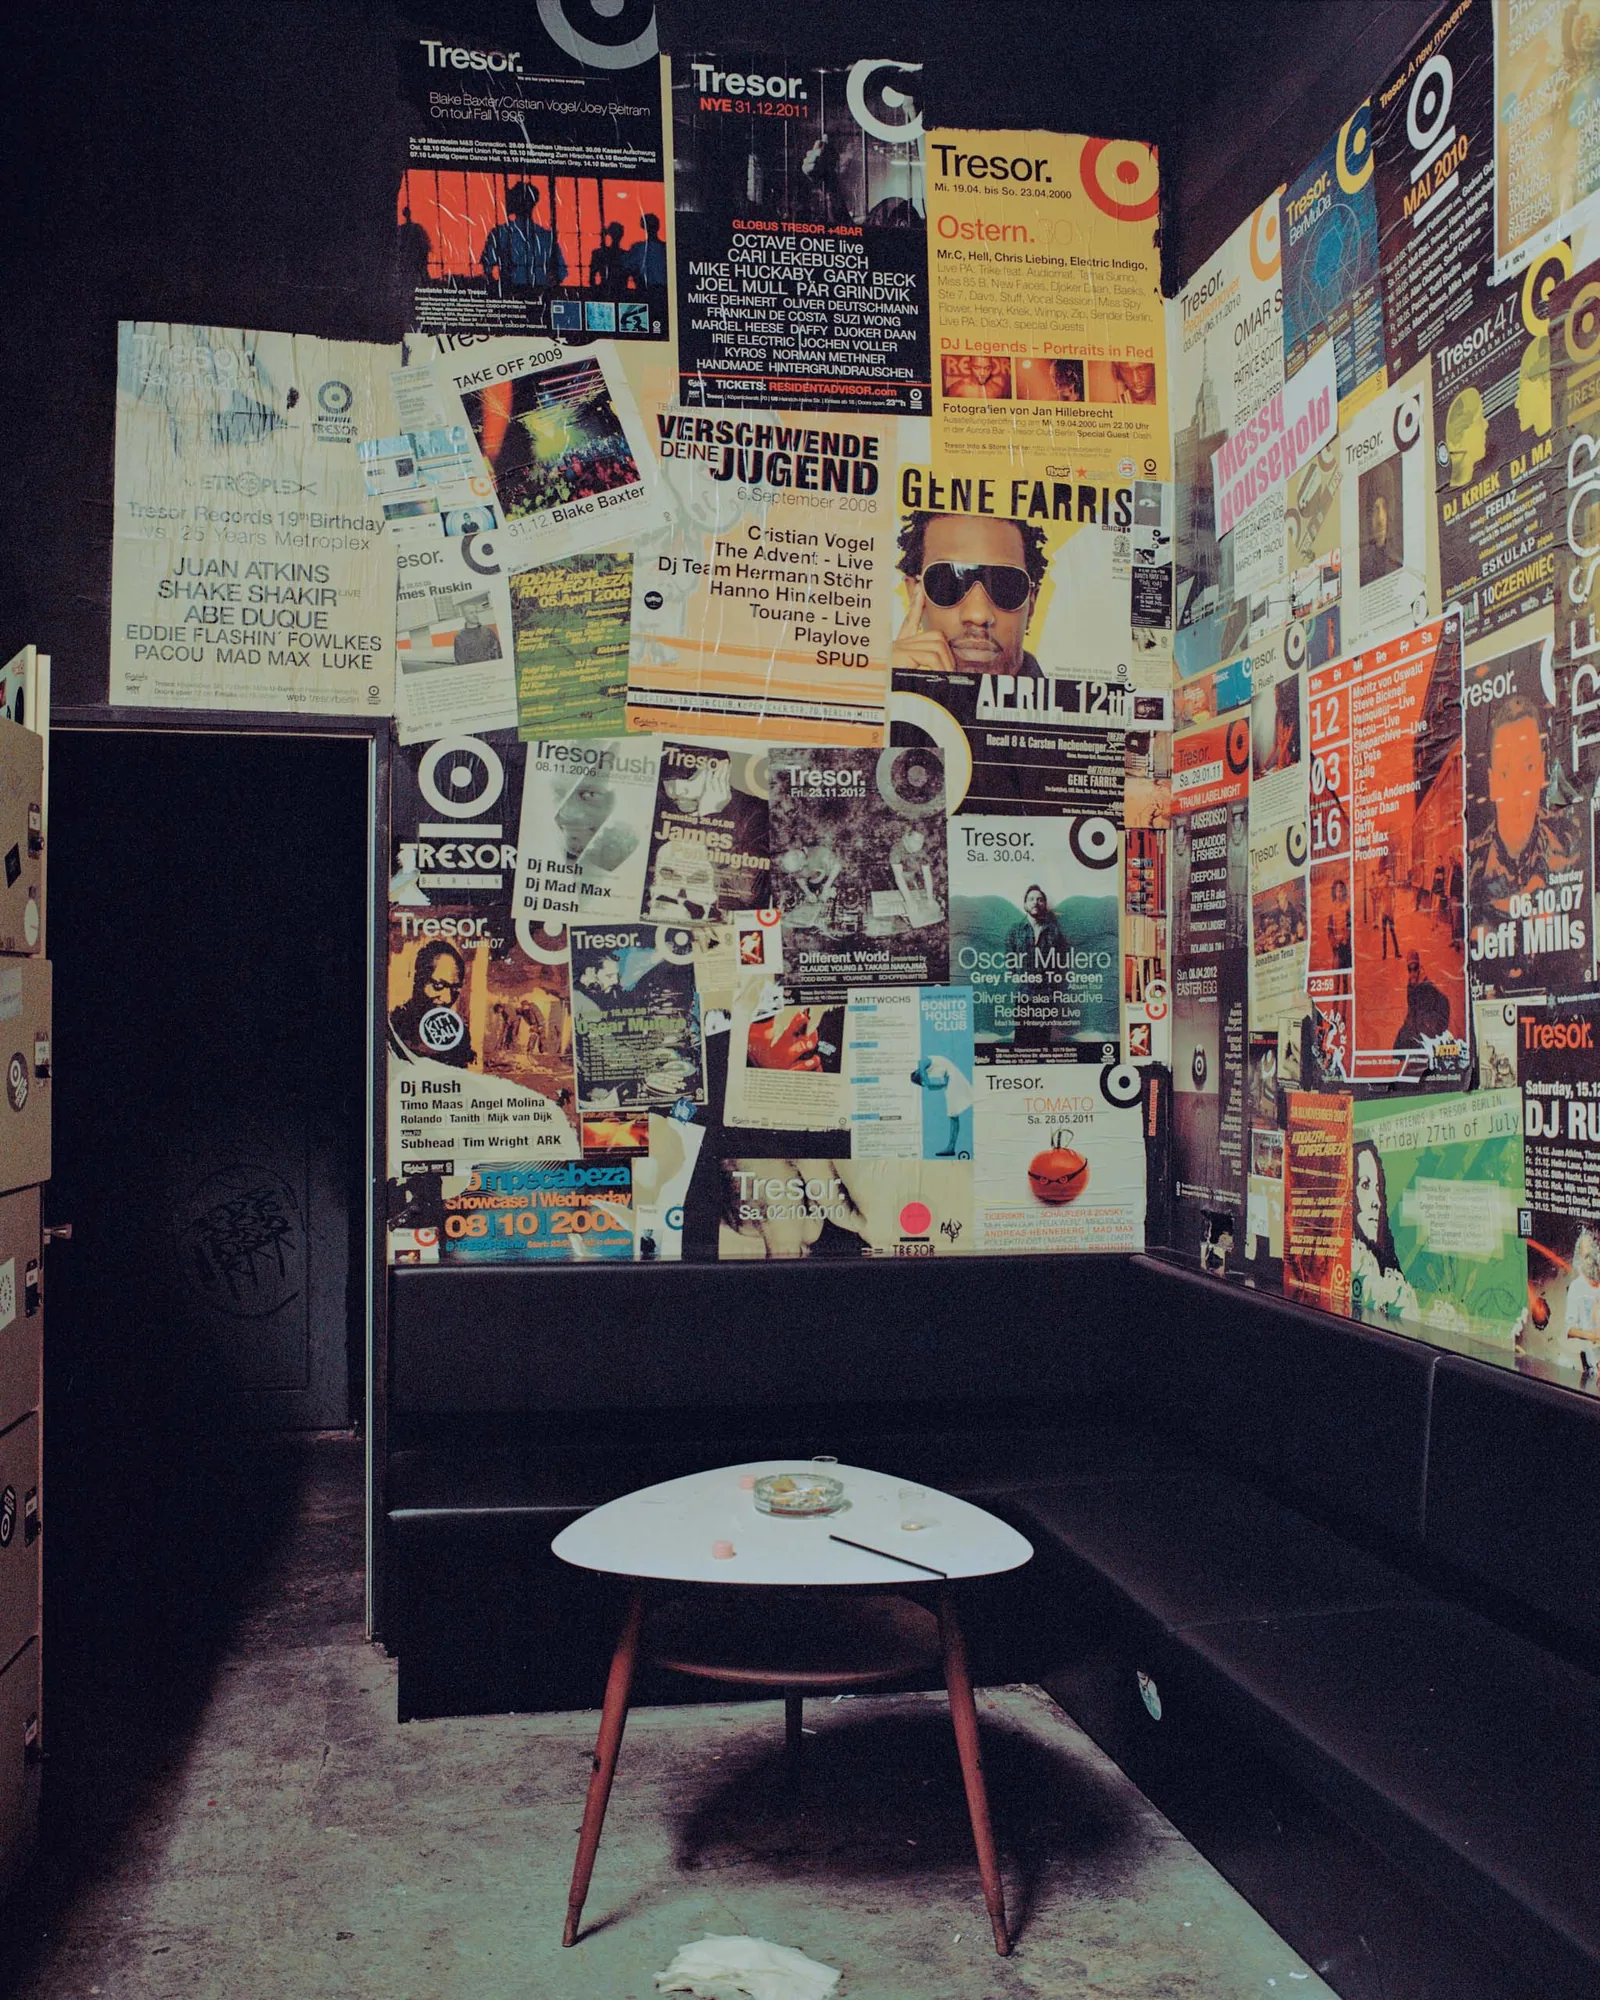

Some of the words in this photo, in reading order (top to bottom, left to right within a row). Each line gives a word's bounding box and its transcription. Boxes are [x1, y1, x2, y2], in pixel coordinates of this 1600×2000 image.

[420, 39, 523, 72] Tresor.
[691, 63, 807, 99] Tresor.
[429, 92, 462, 106] Blake
[547, 99, 607, 115] Vogel/Joey
[608, 103, 650, 116] Beltram
[474, 108, 491, 119] Fall
[494, 109, 525, 122] 1995
[699, 98, 732, 112] NYE
[735, 100, 808, 118] 31.12.2011
[932, 144, 1052, 182] Tresor.
[1403, 172, 1431, 220] MAI
[1434, 134, 1468, 185] 2010
[952, 184, 982, 194] 19.04.
[1002, 186, 1018, 196] So.
[1021, 188, 1071, 199] 23.04.2000
[1286, 171, 1331, 227] Tresor.
[937, 215, 1035, 243] Ostern.
[732, 234, 795, 250] OCTAVE
[800, 237, 835, 251] ONE
[839, 240, 864, 253] live
[728, 249, 765, 264] CARI
[772, 251, 868, 269] LEKEBUSCH
[937, 250, 966, 262] Mr.C,
[968, 251, 991, 262] Hell,
[994, 252, 1022, 263] Chris
[1025, 254, 1068, 267] Liebing,
[1070, 256, 1109, 267] Electric
[1112, 259, 1148, 271] Indigo,
[689, 262, 729, 277] MIKE
[734, 264, 814, 281] HUCKABY
[824, 270, 867, 284] GARY
[873, 273, 916, 287] BECK
[696, 278, 737, 293] JOEL
[743, 280, 787, 295] MULL
[797, 281, 830, 297] PÄR
[834, 285, 909, 301] GRINDVIK
[1181, 269, 1224, 321] Tresor.
[1438, 319, 1495, 376] Tresor.
[453, 370, 494, 390] TAKE
[496, 359, 525, 376] OFF
[529, 348, 563, 368] 2009
[716, 379, 766, 390] TICKETS:
[769, 382, 897, 396] RESIDENTADVISOR.com
[1009, 406, 1030, 414] von
[1033, 405, 1052, 416] Jan
[1055, 407, 1113, 418] Hillebrecht
[657, 414, 878, 460] VERSCHWENDE
[1345, 430, 1383, 464] Tresor.
[661, 440, 719, 462] DEINE
[709, 447, 878, 495] JUGEND
[552, 499, 594, 523] Blake
[597, 486, 645, 509] Baxter
[901, 468, 996, 514] GENE
[1011, 480, 1132, 527] FARRIS
[1443, 501, 1457, 518] DJ
[1462, 473, 1500, 510] KRIEK
[194, 505, 272, 525] Records
[310, 513, 385, 534] Birthday
[748, 525, 818, 546] Cristian
[825, 533, 874, 552] Vogel
[1482, 537, 1535, 577] ESKULAP
[173, 557, 238, 578] JUAN
[245, 561, 330, 583] ATKINS
[736, 566, 819, 585] Hermann
[824, 573, 873, 589] Stöhr
[158, 580, 241, 601] SHAKE
[248, 585, 337, 606] SHAKIR
[429, 581, 472, 595] Ruskin
[776, 586, 872, 609] Hinkelbein
[184, 606, 234, 625] ABE
[241, 608, 328, 630] DUQUE
[126, 624, 186, 642] EDDIE
[288, 633, 382, 650] FOWLKES
[794, 627, 870, 648] Playlove
[135, 644, 204, 662] PACOU
[216, 648, 261, 664] MAD
[268, 651, 310, 667] MAX
[322, 653, 373, 669] LUKE
[816, 651, 869, 668] SPUD
[1353, 680, 1377, 699] Moritz
[1379, 675, 1392, 690] von
[1394, 661, 1423, 684] Oswald
[1353, 693, 1373, 712] Steve
[1312, 696, 1340, 741] 12
[986, 734, 1009, 746] Recall
[1179, 746, 1210, 766] Tresor.
[536, 762, 596, 776] 08.11.2006
[789, 765, 866, 786] Tresor.
[1312, 752, 1340, 795] 03
[809, 788, 866, 797] 23.11.2012
[961, 827, 1034, 846] Tresor.
[1313, 807, 1341, 850] 16
[528, 858, 542, 873] Dj
[547, 861, 583, 875] Rush
[967, 851, 988, 862] Sa.
[994, 850, 1034, 862] 30.04.
[1191, 867, 1227, 883] DEEPCHILD
[525, 878, 542, 892] Dj
[545, 880, 576, 893] Mad
[580, 883, 611, 897] Max
[1509, 884, 1583, 919] 06.10.07
[394, 910, 491, 937] Tresor.
[572, 931, 641, 949] Tresor.
[1471, 921, 1516, 961] Jeff
[1524, 914, 1585, 955] Mills
[800, 951, 851, 963] Different
[854, 951, 889, 962] World
[958, 947, 1027, 969] Oscar
[1035, 947, 1111, 969] Mulero
[970, 972, 1000, 985] Grey
[1004, 972, 1042, 983] Fades
[1065, 971, 1102, 983] Green
[855, 996, 911, 1004] MITTWOCHS
[921, 1000, 966, 1011] BONITO
[925, 1010, 967, 1021] HOUSE
[994, 1005, 1058, 1019] Redshape
[1061, 1008, 1080, 1017] Live
[934, 1021, 967, 1031] CLUB
[1520, 1016, 1593, 1049] Tresor.
[401, 1081, 416, 1097] Dj
[422, 1080, 461, 1094] Rush
[986, 1075, 1044, 1090] Tresor.
[1525, 1080, 1573, 1099] Saturday,
[401, 1099, 428, 1110] Timo
[431, 1099, 464, 1110] Maas
[471, 1098, 503, 1110] Angel
[507, 1097, 545, 1109] Molina
[1024, 1098, 1093, 1113] TOMATO
[1440, 1102, 1467, 1119] TRESOR
[1472, 1096, 1501, 1113] BERLIN
[401, 1113, 442, 1125] Rolando
[450, 1112, 480, 1123] Tanith
[1027, 1116, 1041, 1124] Sa.
[1045, 1115, 1093, 1124] 28.05.2011
[1525, 1099, 1559, 1139] DJ
[1379, 1130, 1418, 1150] Friday
[1427, 1122, 1456, 1143] 27th
[1487, 1113, 1519, 1136] July
[732, 1171, 845, 1201] Tresor.
[739, 1205, 762, 1220] Sa.
[767, 1205, 844, 1220] 02.10.2010
